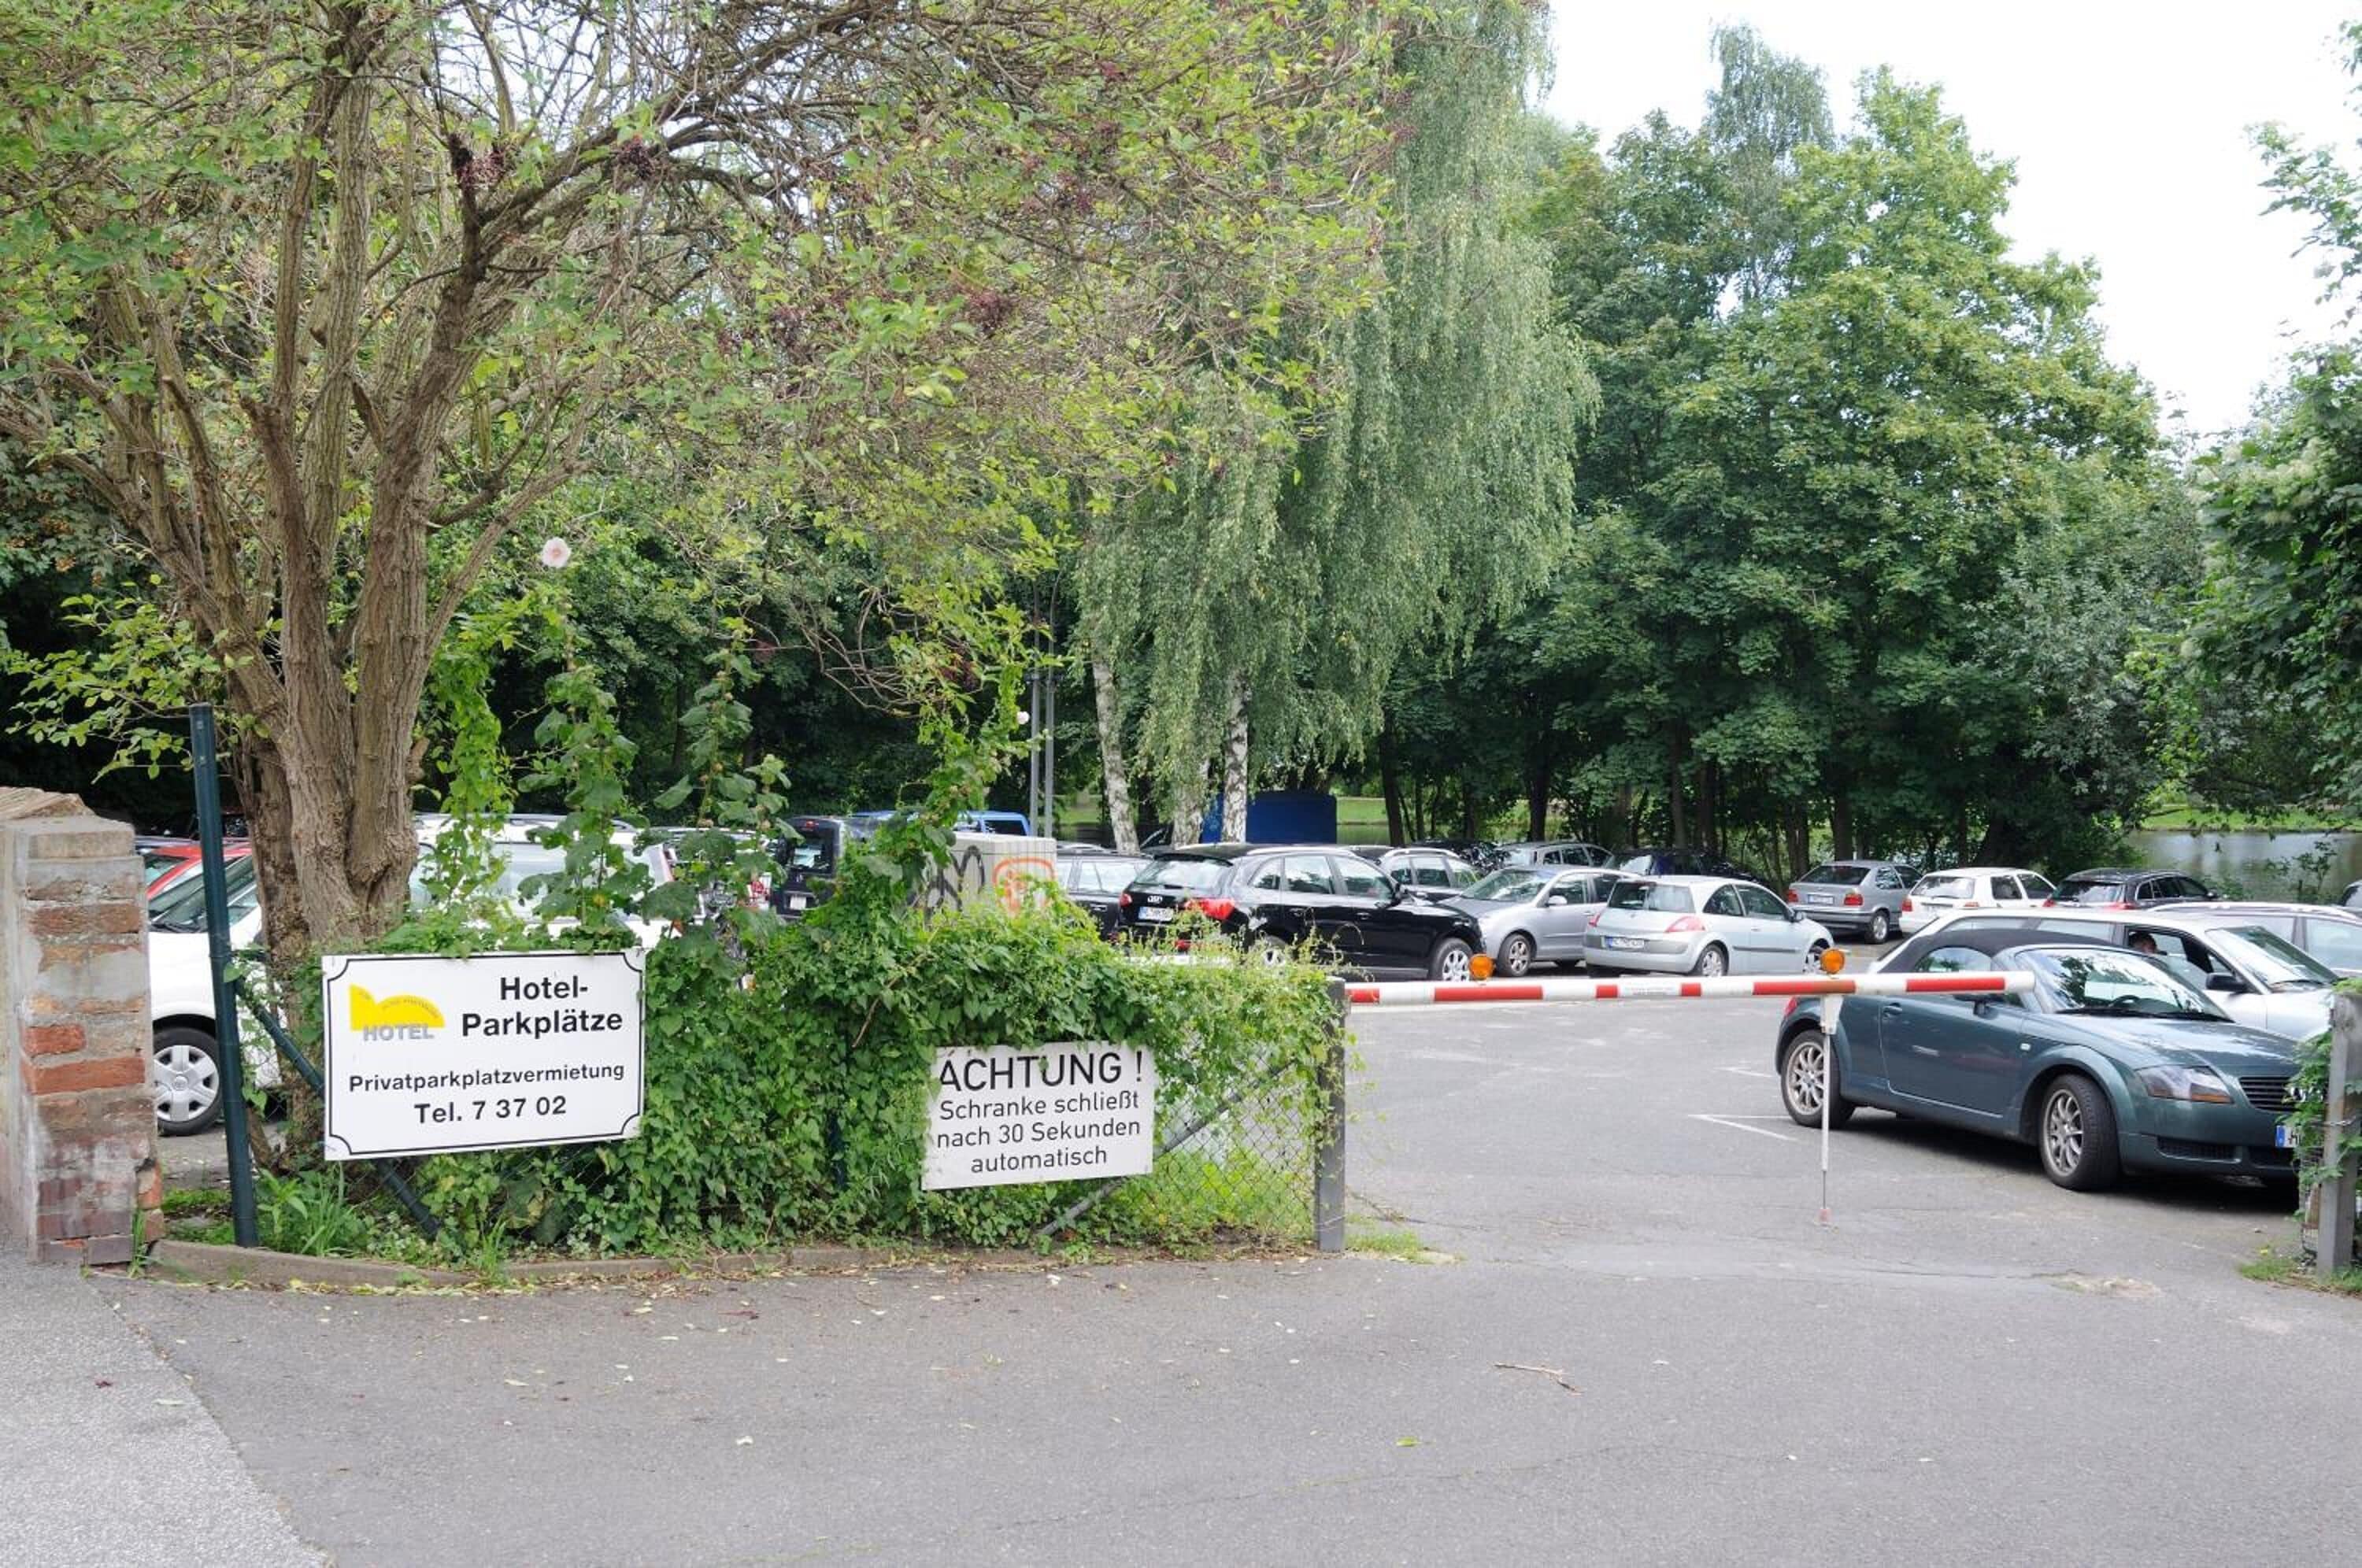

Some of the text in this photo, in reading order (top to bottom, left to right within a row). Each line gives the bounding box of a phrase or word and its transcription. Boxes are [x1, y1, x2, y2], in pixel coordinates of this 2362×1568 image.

[501, 975, 588, 1000] Hotel-
[363, 1023, 435, 1041] HOTEL
[461, 1009, 623, 1040] Parkplätze
[349, 1063, 625, 1093] Privatparkplatzvermietung
[939, 1052, 1122, 1092] ACHTUNG
[413, 1095, 567, 1124] Tel. 7 37 02
[939, 1090, 1139, 1120] Schranke schließt
[937, 1117, 1140, 1148] nach 30 Sekunden
[971, 1145, 1107, 1174] automatisch
